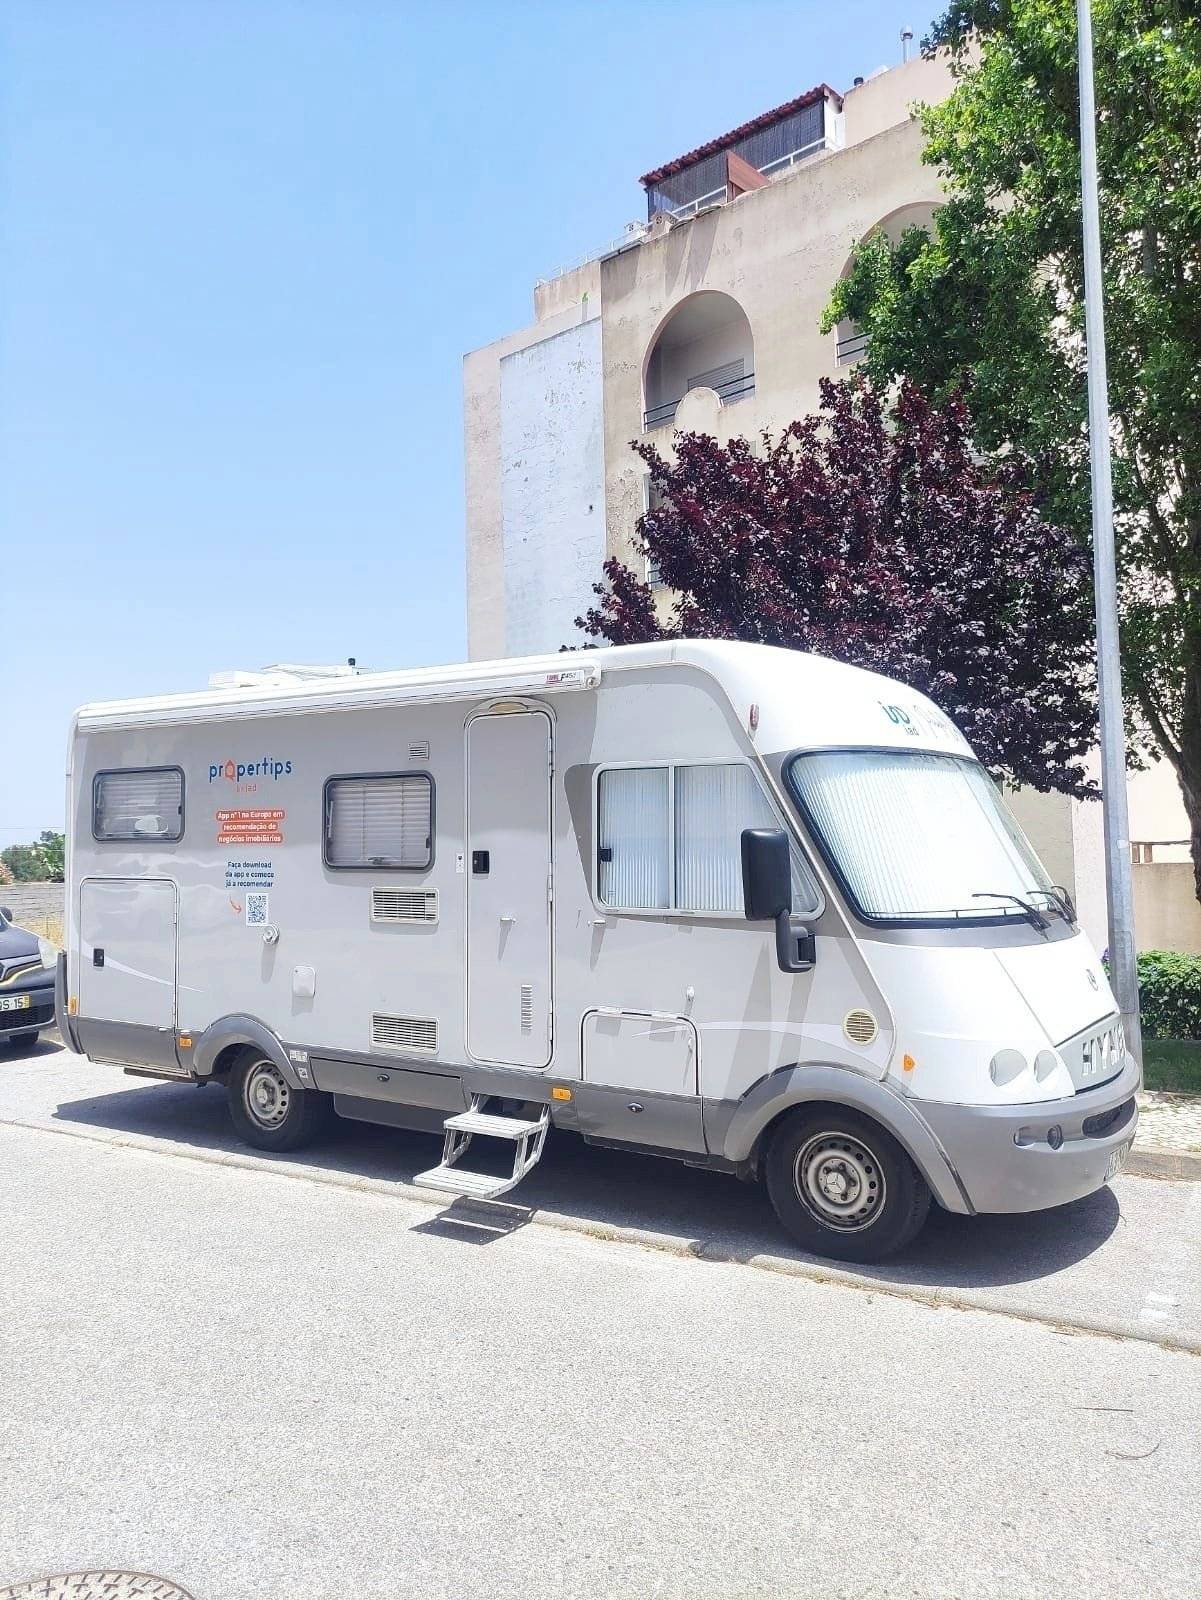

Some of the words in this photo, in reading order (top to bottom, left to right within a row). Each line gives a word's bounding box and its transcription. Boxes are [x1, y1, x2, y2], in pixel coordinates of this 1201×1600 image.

[209, 757, 292, 783] propertips
[224, 823, 266, 831] recomendação
[225, 880, 232, 888] já
